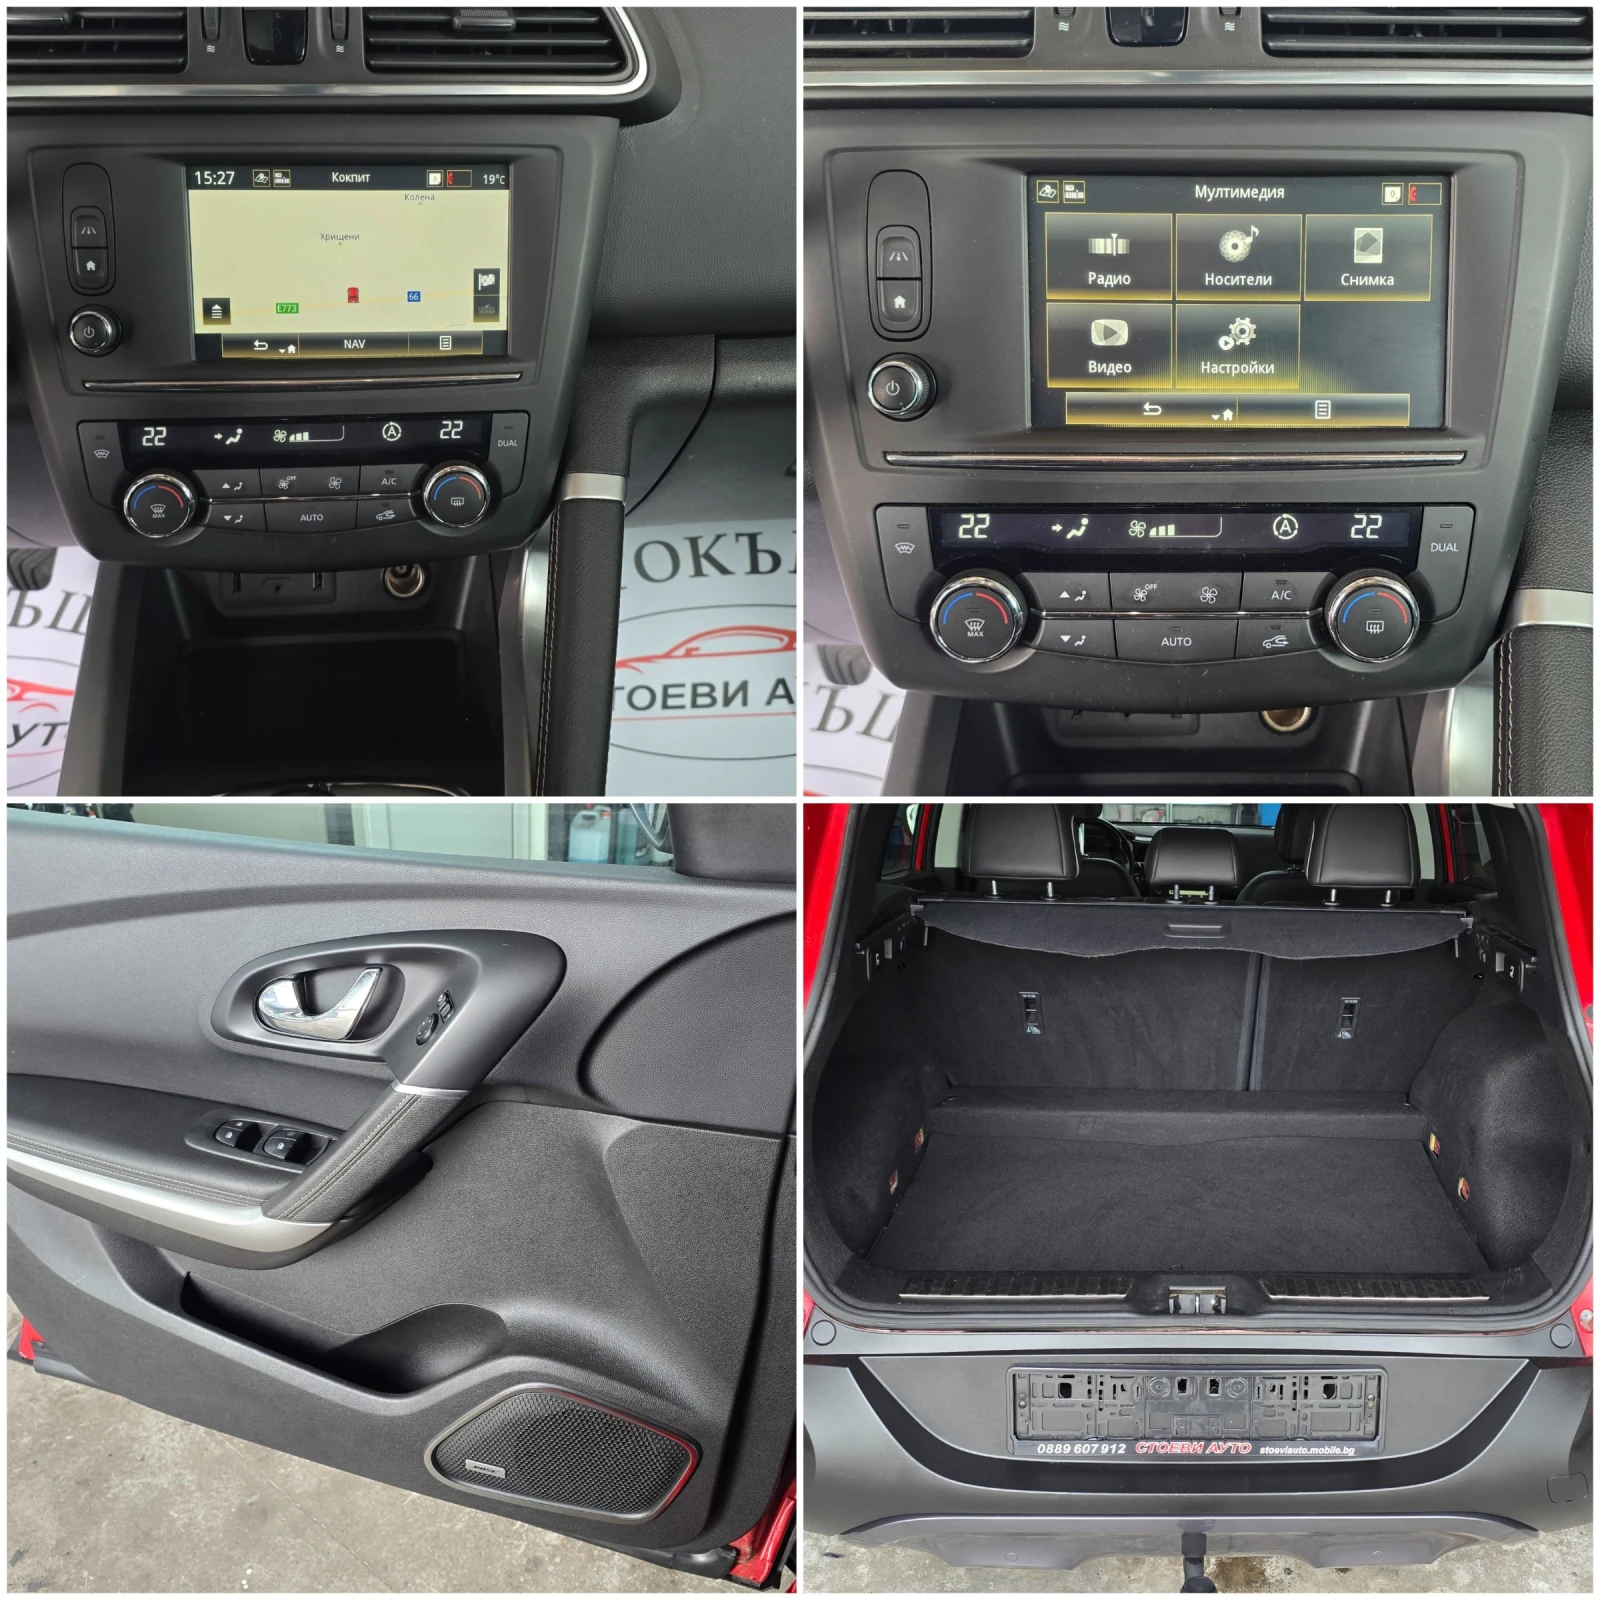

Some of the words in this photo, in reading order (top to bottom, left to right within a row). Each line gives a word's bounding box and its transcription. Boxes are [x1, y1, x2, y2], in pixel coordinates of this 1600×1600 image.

[194, 170, 236, 186] 15:27
[331, 171, 371, 186] Кокпит
[404, 191, 435, 202] Колена
[1194, 185, 1285, 201] Мултимедия
[319, 231, 361, 243] Хрищени
[1087, 271, 1132, 289] Радио
[1204, 272, 1273, 287] Носители
[1340, 272, 1395, 288] Снимка
[408, 291, 420, 301] 66
[277, 303, 297, 313] E773
[343, 338, 366, 350] NAV
[1087, 360, 1133, 376] Видео
[1200, 360, 1275, 379] Настройки
[142, 426, 167, 446] 22
[439, 420, 464, 439] 22
[497, 439, 519, 447] DUAL
[381, 477, 397, 486] A/C
[300, 513, 324, 522] AUTO
[958, 514, 991, 540] 22
[1350, 514, 1383, 540] 22
[1430, 541, 1459, 553] DUAL
[1271, 589, 1292, 601] A/C
[1161, 637, 1192, 647] AUTO
[1037, 1443, 1071, 1454] 0889
[1073, 1443, 1100, 1454] 607
[1100, 1443, 1126, 1454] 912
[1135, 1441, 1205, 1454] СТОЕВИ
[1205, 1441, 1252, 1454] АУТО
[1259, 1445, 1356, 1456] stoeviauto.mobile.bg
